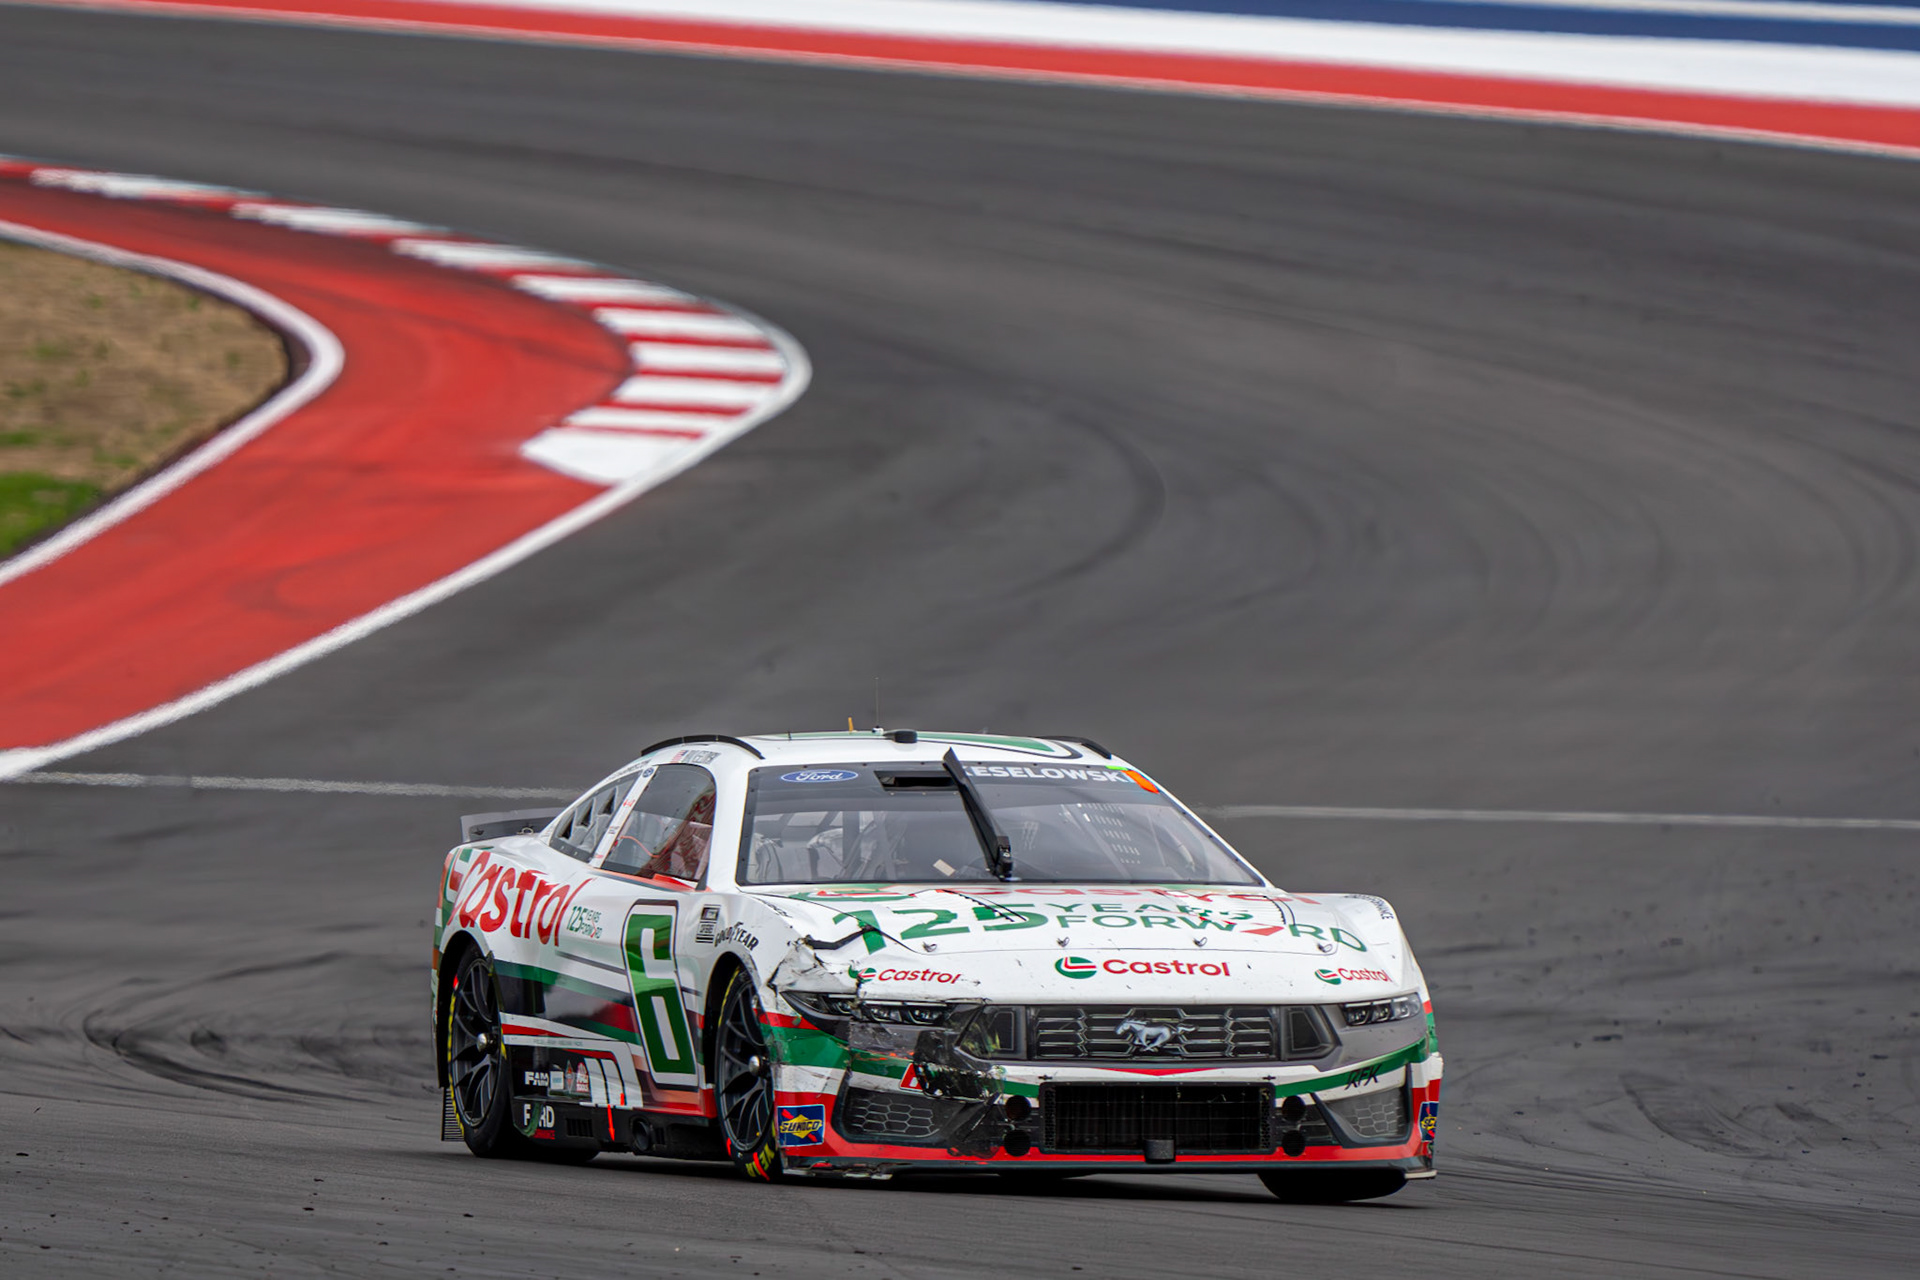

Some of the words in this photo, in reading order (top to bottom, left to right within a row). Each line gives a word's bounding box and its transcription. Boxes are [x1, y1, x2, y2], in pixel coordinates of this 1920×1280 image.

[796, 770, 844, 781] Ford
[447, 851, 597, 947] Castrol
[1045, 903, 1254, 920] YEARS
[567, 906, 588, 932] 125
[832, 903, 1049, 955] 125
[714, 923, 759, 951] GOODYEAR
[878, 967, 962, 985] Castrol
[1102, 958, 1231, 977] Castrol
[1338, 967, 1393, 983] Castrol
[624, 905, 698, 1083] 6
[1344, 1064, 1381, 1090] RFK
[523, 1103, 555, 1128] FRD
[781, 1120, 821, 1132] SUNOCO
